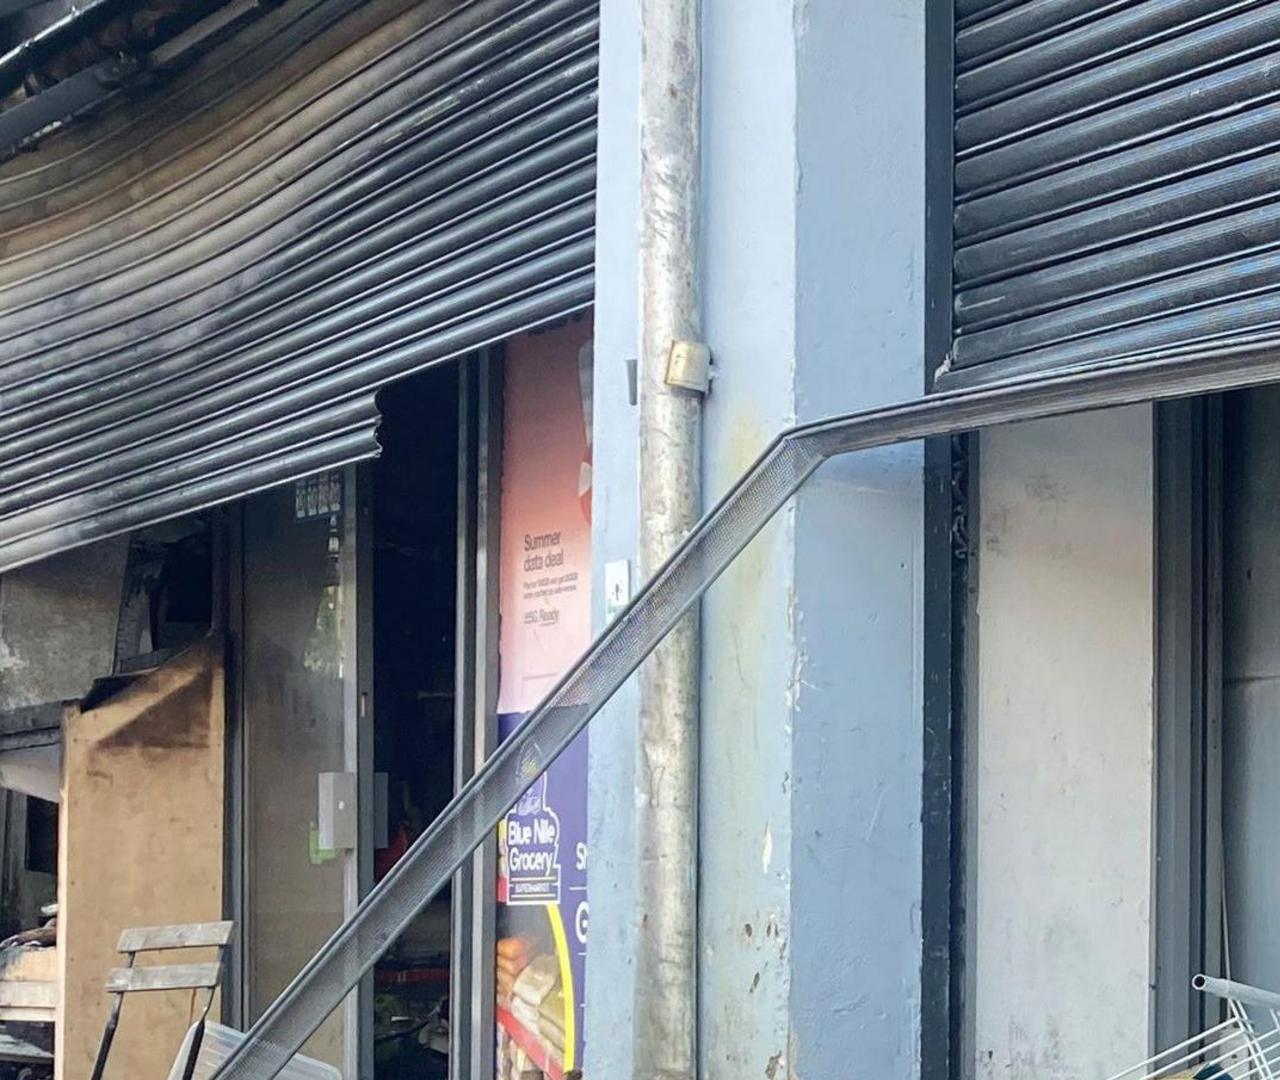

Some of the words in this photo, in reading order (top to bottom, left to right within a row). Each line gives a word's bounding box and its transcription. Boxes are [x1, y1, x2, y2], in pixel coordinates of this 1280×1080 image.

[523, 531, 561, 552] Summer
[523, 554, 544, 572] data
[545, 548, 564, 568] deal
[508, 820, 532, 846] Blue
[534, 818, 556, 845] Nile
[509, 847, 553, 877] Grocery
